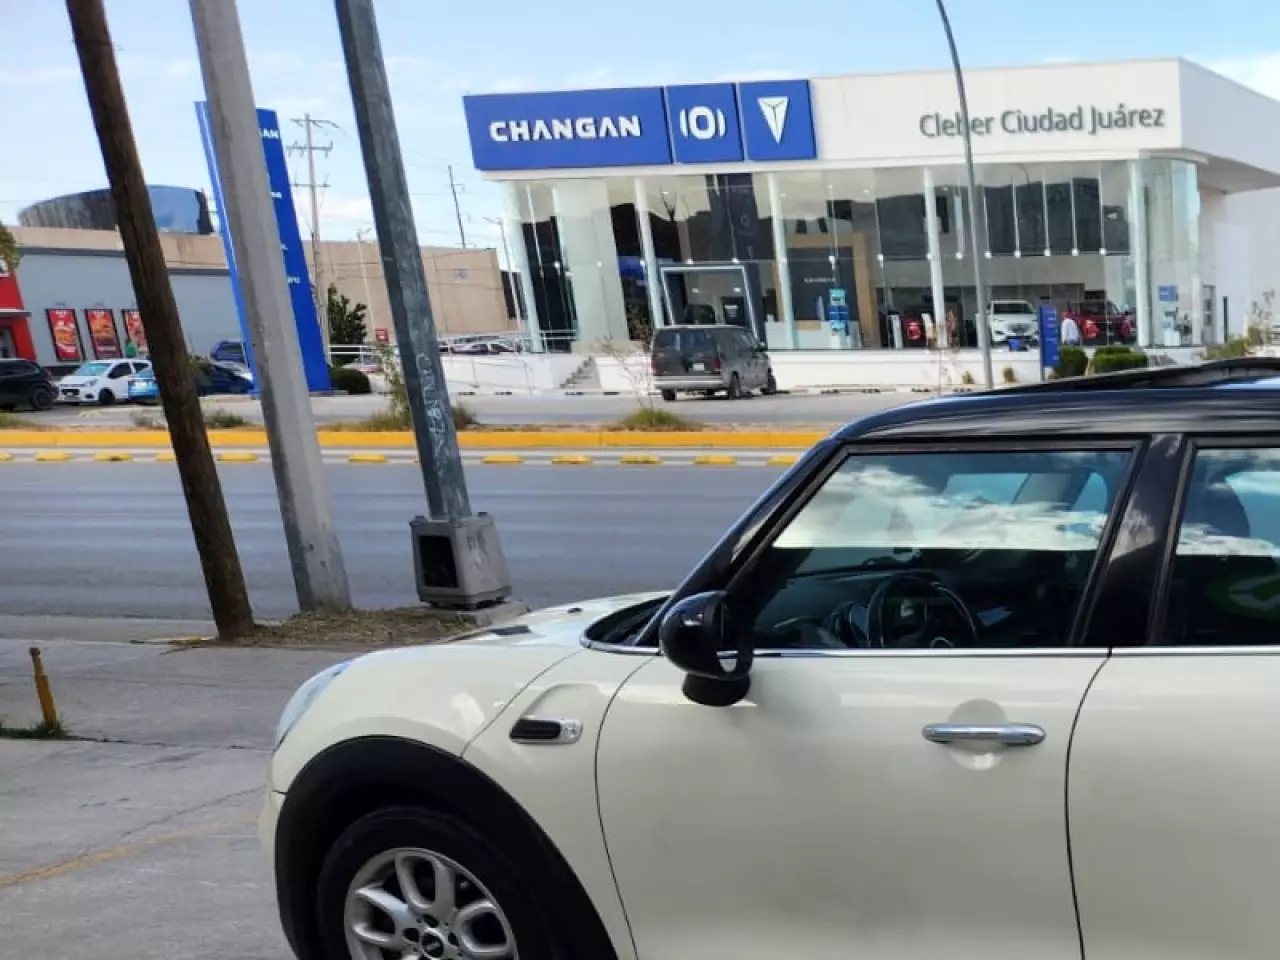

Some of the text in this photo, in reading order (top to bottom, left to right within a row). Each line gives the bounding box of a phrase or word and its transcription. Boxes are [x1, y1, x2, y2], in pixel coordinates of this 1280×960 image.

[488, 114, 642, 142] CHANGAN
[1000, 105, 1084, 134] Ciudad
[1088, 103, 1166, 136] Juárez
